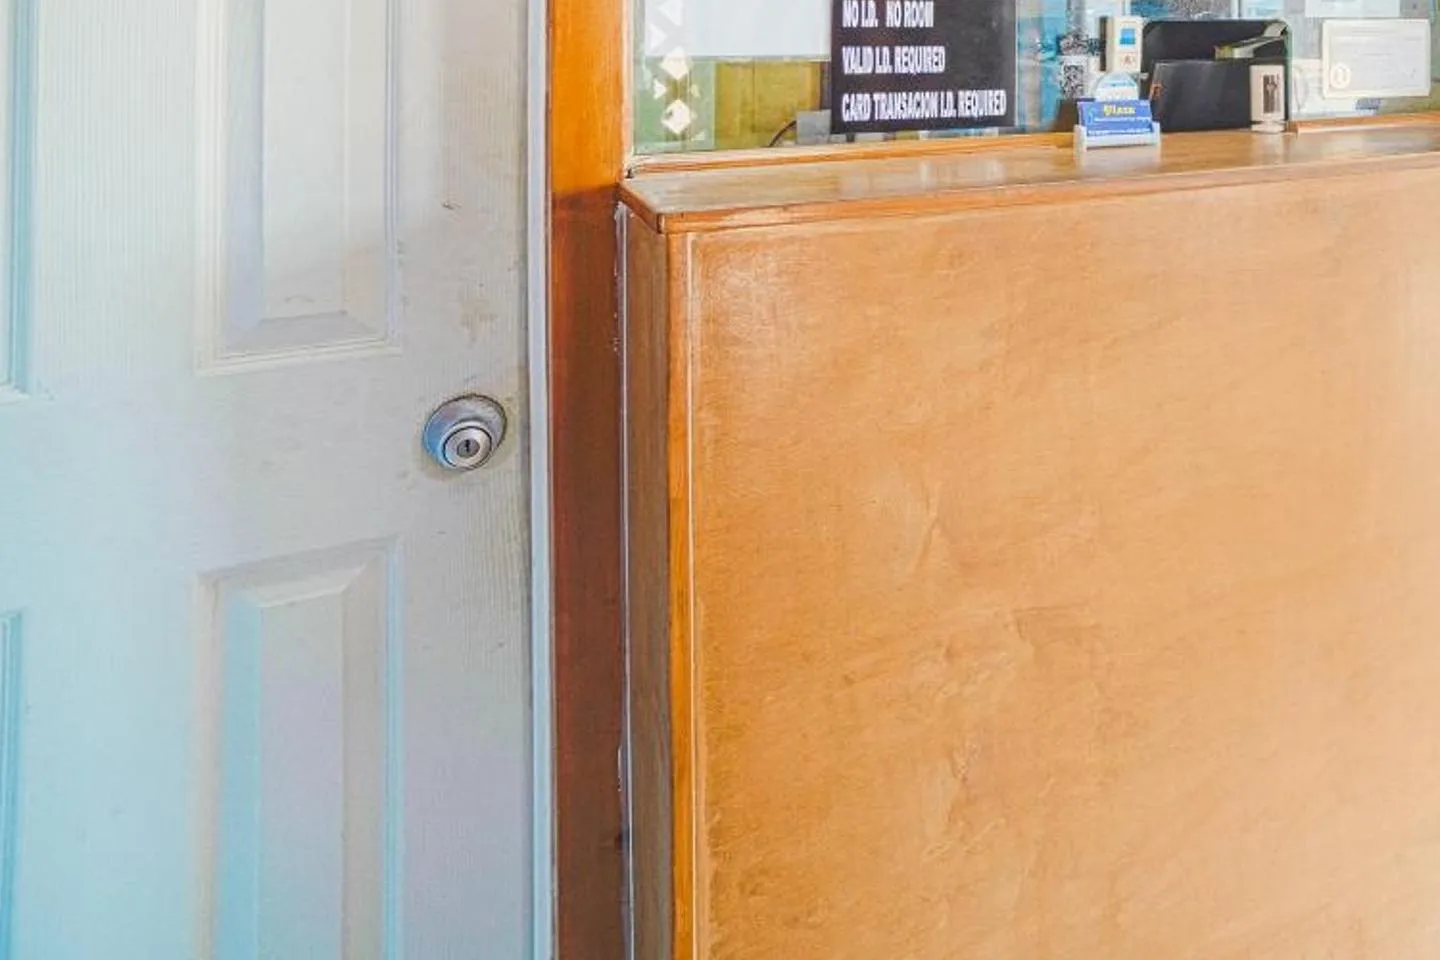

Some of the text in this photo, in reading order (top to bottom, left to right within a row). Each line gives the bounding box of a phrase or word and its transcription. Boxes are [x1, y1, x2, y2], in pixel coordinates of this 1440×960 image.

[842, 0, 859, 28] NO
[886, 0, 902, 28] NO
[904, 0, 934, 28] ROOM
[842, 46, 874, 75] VALID
[894, 46, 946, 75] REQUIRED
[842, 93, 871, 122] CARD
[958, 90, 1007, 118] REQUIRED
